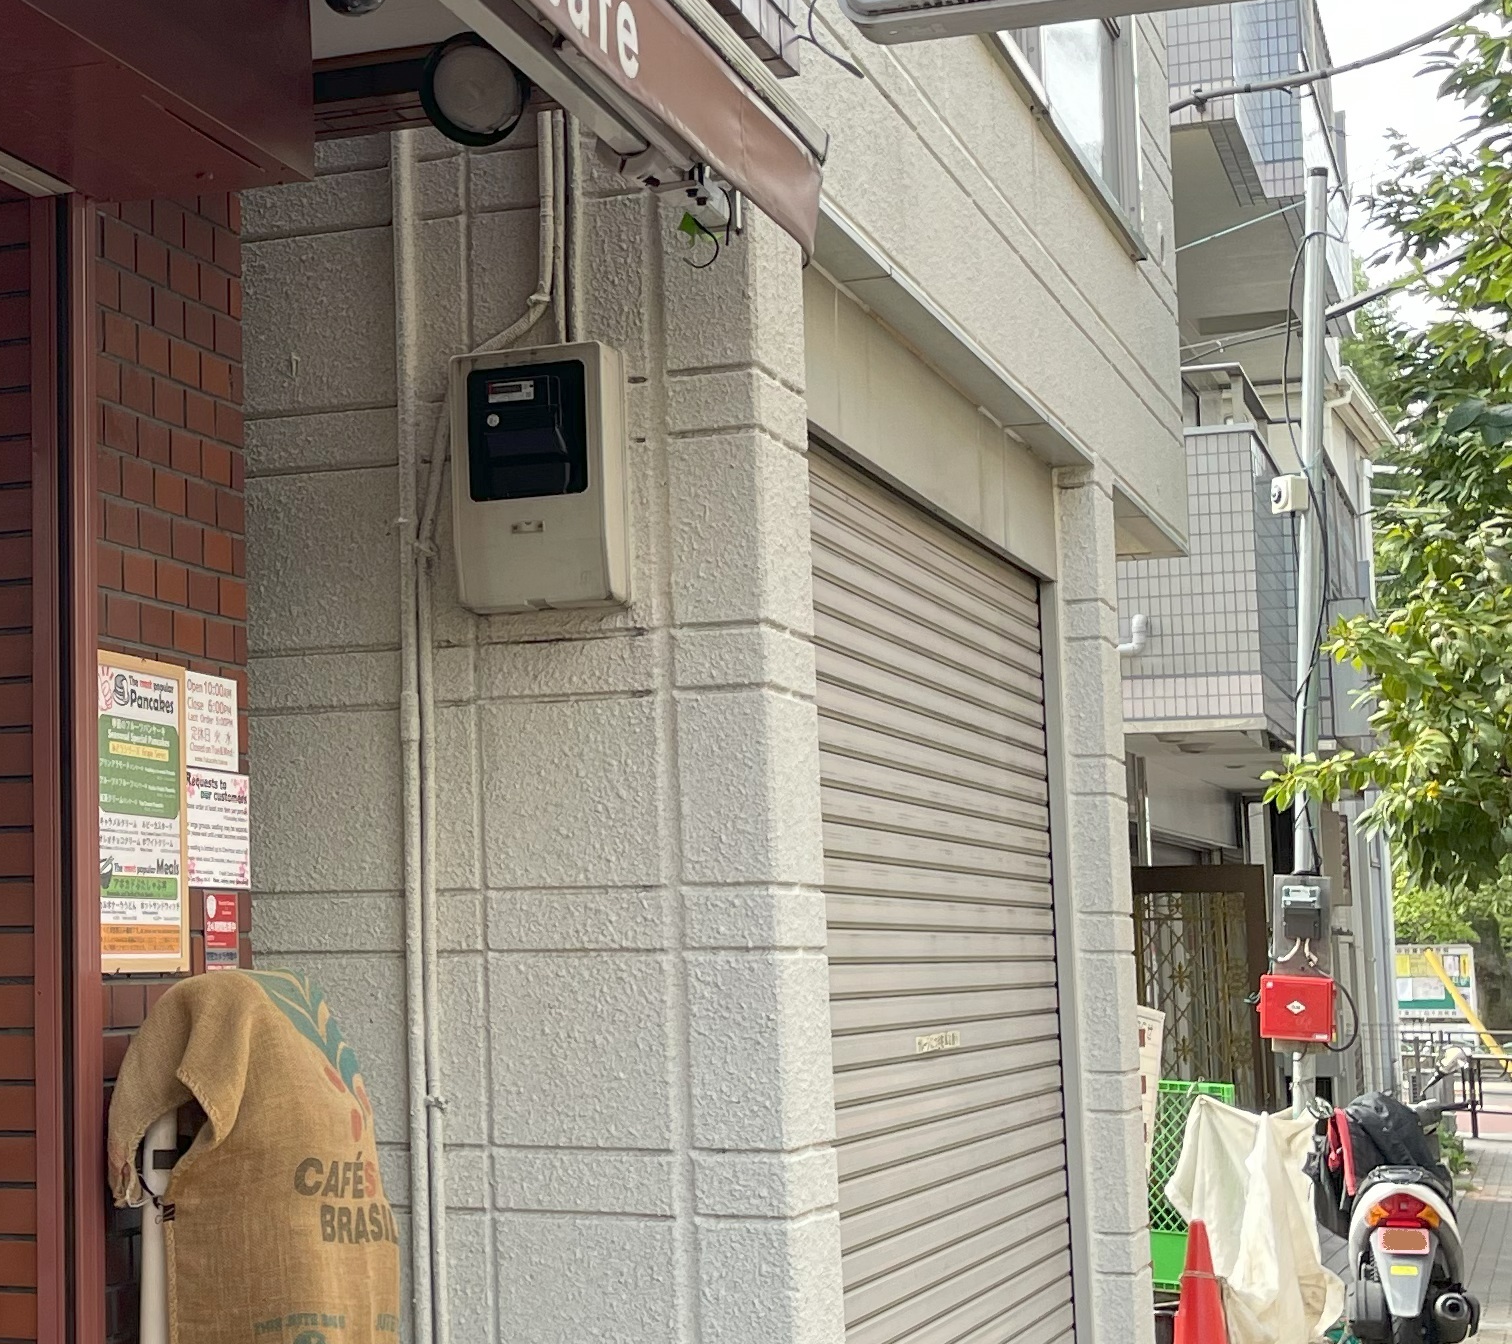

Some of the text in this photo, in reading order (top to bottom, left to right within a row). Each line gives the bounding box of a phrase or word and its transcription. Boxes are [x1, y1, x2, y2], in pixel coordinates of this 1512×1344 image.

[130, 688, 174, 714] Pancakes
[187, 771, 219, 790] Requests
[219, 779, 227, 790] to
[294, 1150, 377, 1199] CAFÉS
